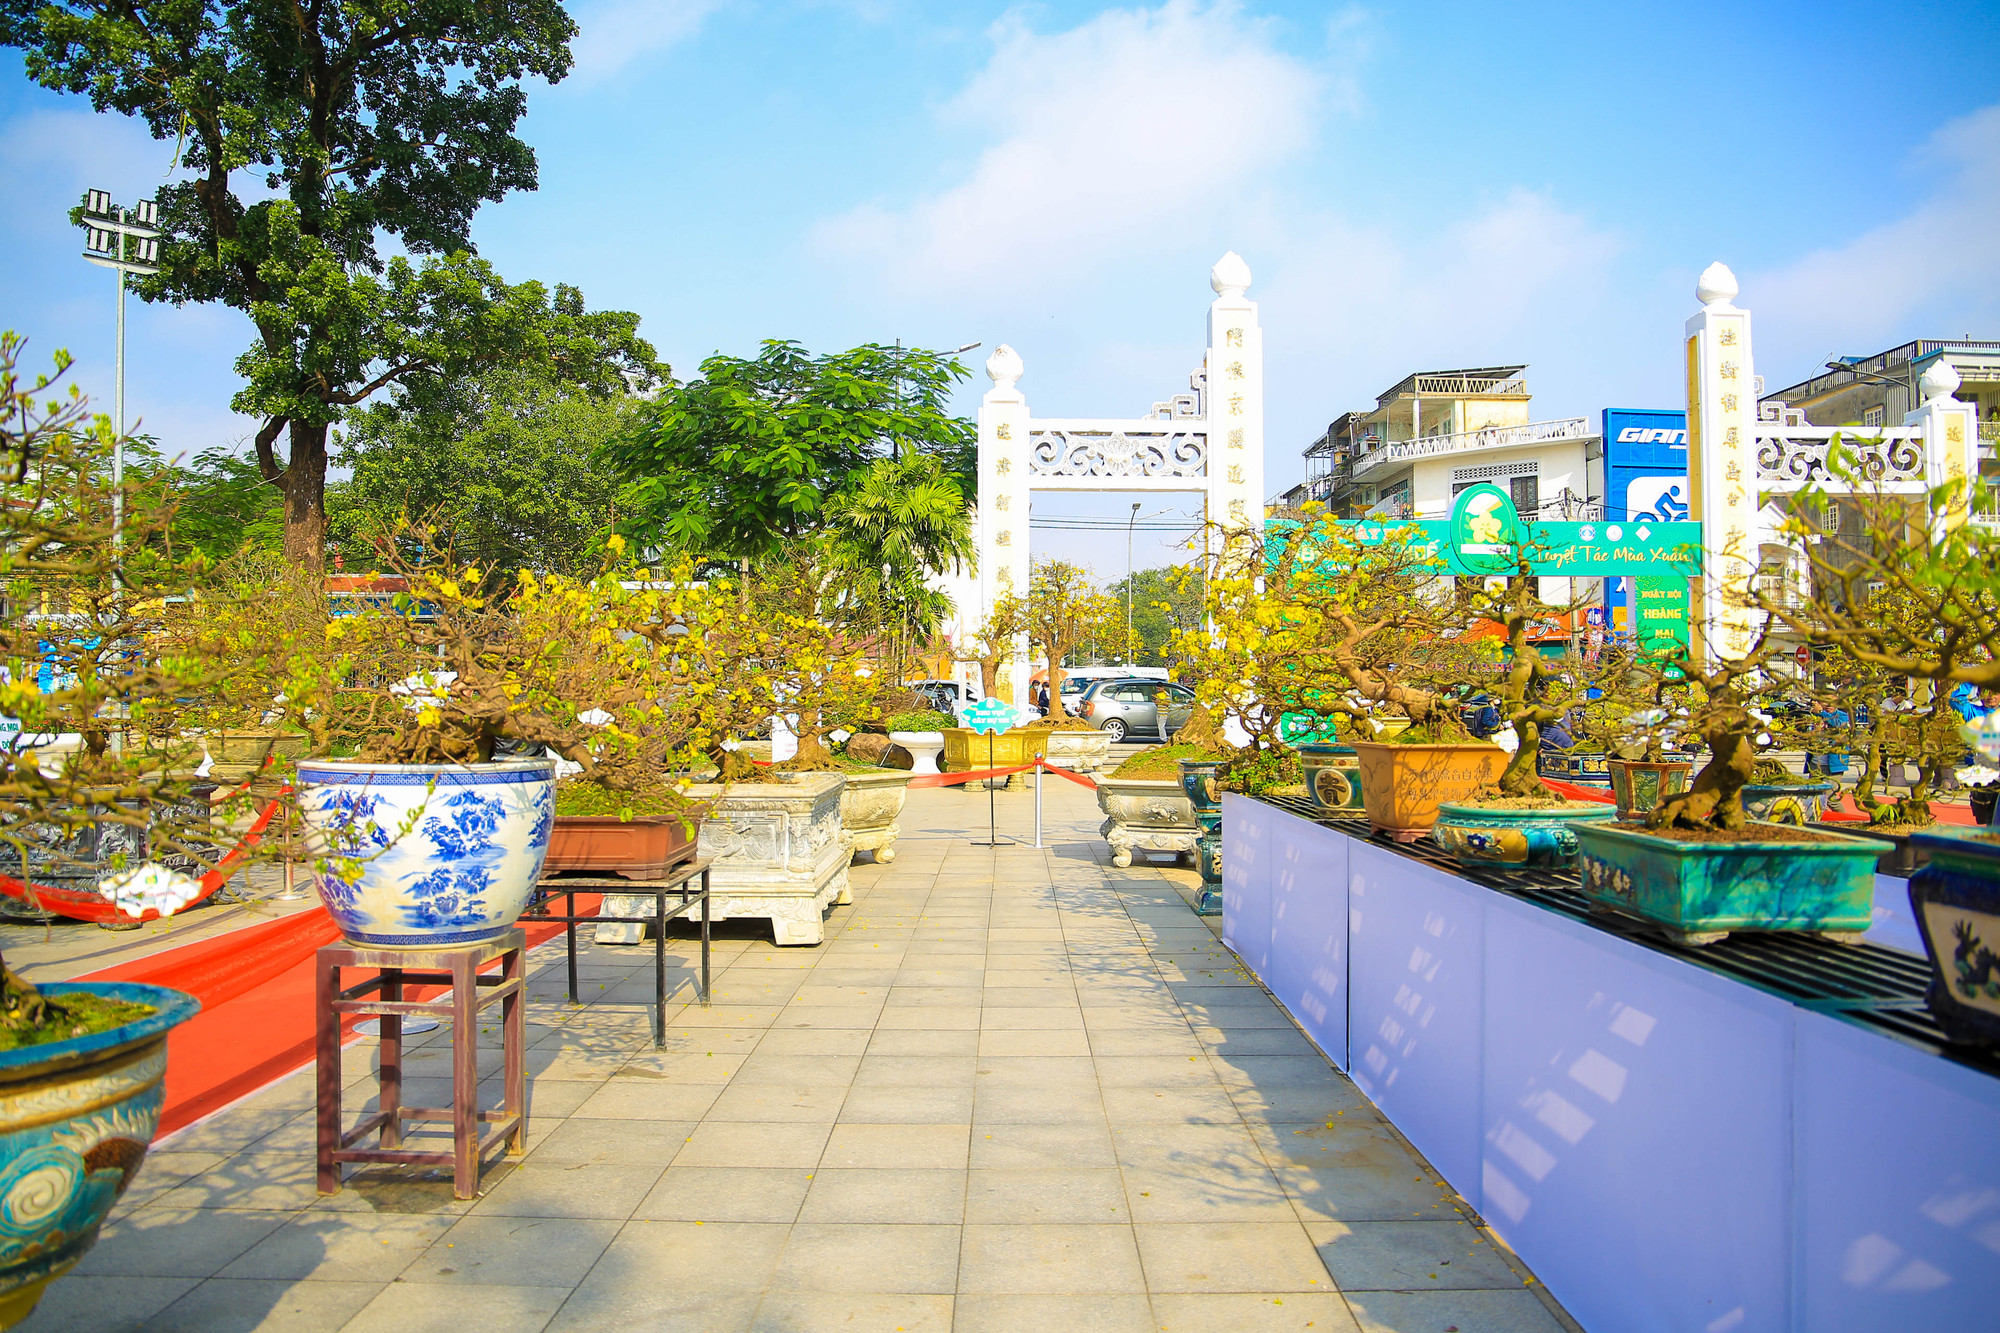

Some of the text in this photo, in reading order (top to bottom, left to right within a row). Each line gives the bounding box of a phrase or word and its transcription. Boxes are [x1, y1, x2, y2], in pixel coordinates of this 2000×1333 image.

[1616, 427, 1687, 443] GIAN
[1579, 545, 1610, 563] Tác
[1613, 547, 1647, 563] Mùa
[1650, 547, 1691, 563] Xuân
[1643, 607, 1681, 619] HOÀNG
[1655, 629, 1674, 639] MAI
